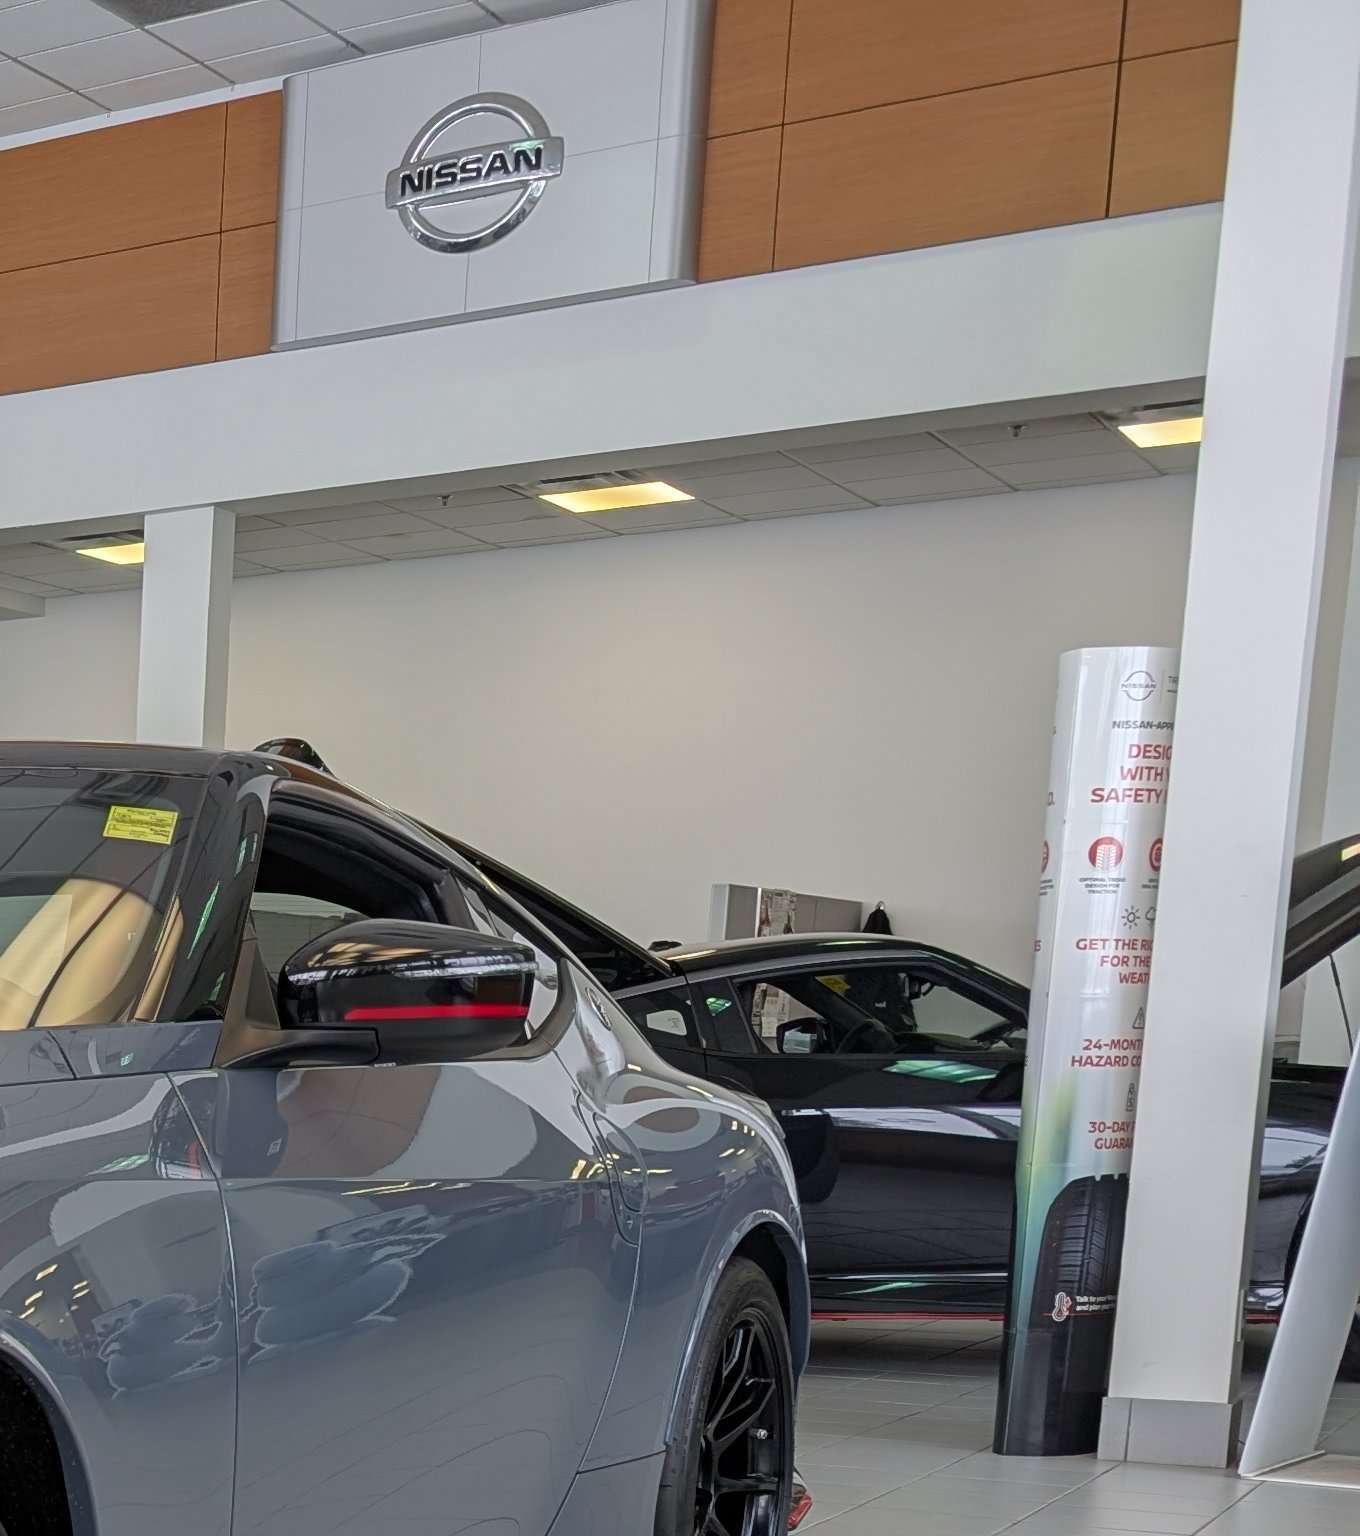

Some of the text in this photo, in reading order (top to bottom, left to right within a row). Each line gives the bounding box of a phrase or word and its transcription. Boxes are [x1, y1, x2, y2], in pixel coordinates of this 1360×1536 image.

[399, 145, 544, 197] NISSAN
[1120, 765, 1163, 782] WITH
[1090, 787, 1162, 804] SAFETY
[1076, 938, 1109, 951] GET
[1114, 938, 1140, 951] THE
[1100, 955, 1151, 968] FOR THE
[1119, 972, 1149, 984] WEAT
[1082, 1039, 1143, 1051] 24-MONT
[1071, 1055, 1129, 1067] HAZARD
[1088, 1121, 1129, 1133] 30-DAY
[1094, 1138, 1133, 1150] GUARA
